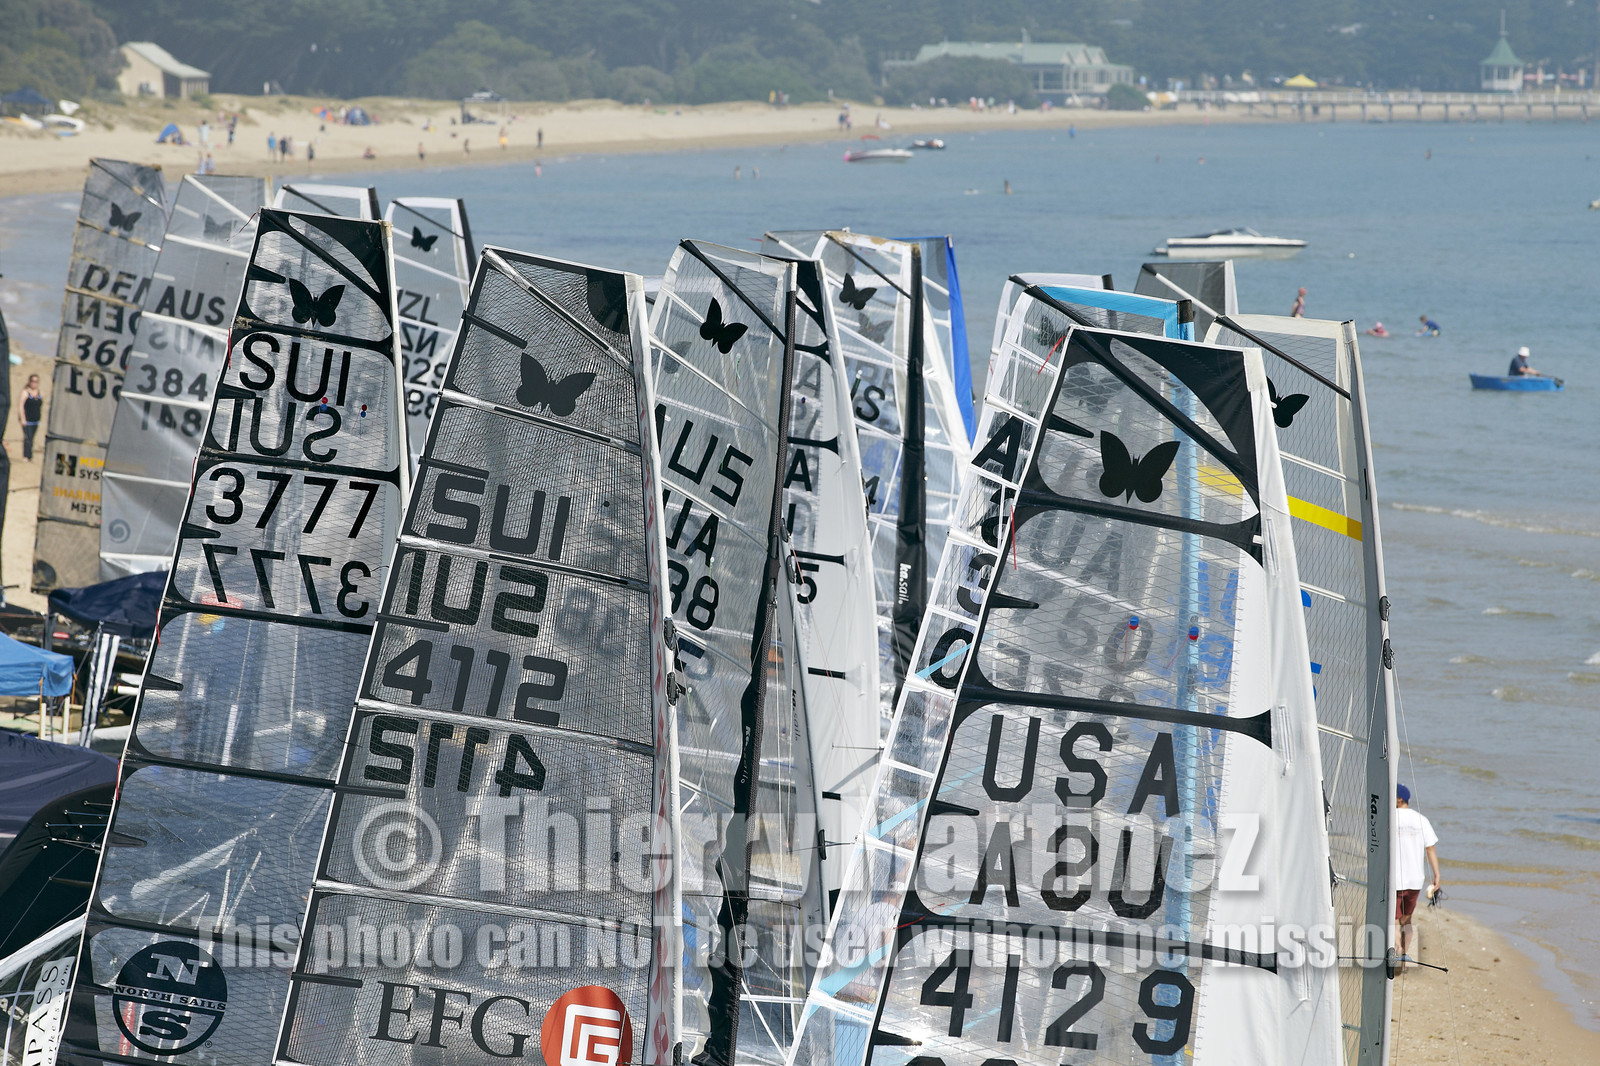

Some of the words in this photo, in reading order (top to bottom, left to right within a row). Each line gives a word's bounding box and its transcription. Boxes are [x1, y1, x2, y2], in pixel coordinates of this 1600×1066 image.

[153, 286, 226, 326] AUS
[136, 364, 208, 402] 384
[239, 332, 351, 406] SUI
[206, 467, 380, 539] 3777
[426, 472, 571, 561] SUI
[383, 639, 567, 726] 4112
[981, 714, 1181, 818] USA
[115, 986, 172, 1000] NORTH
[180, 997, 226, 1010] SAILS
[370, 981, 531, 1059] EFG
[920, 949, 1195, 1055] 4129
